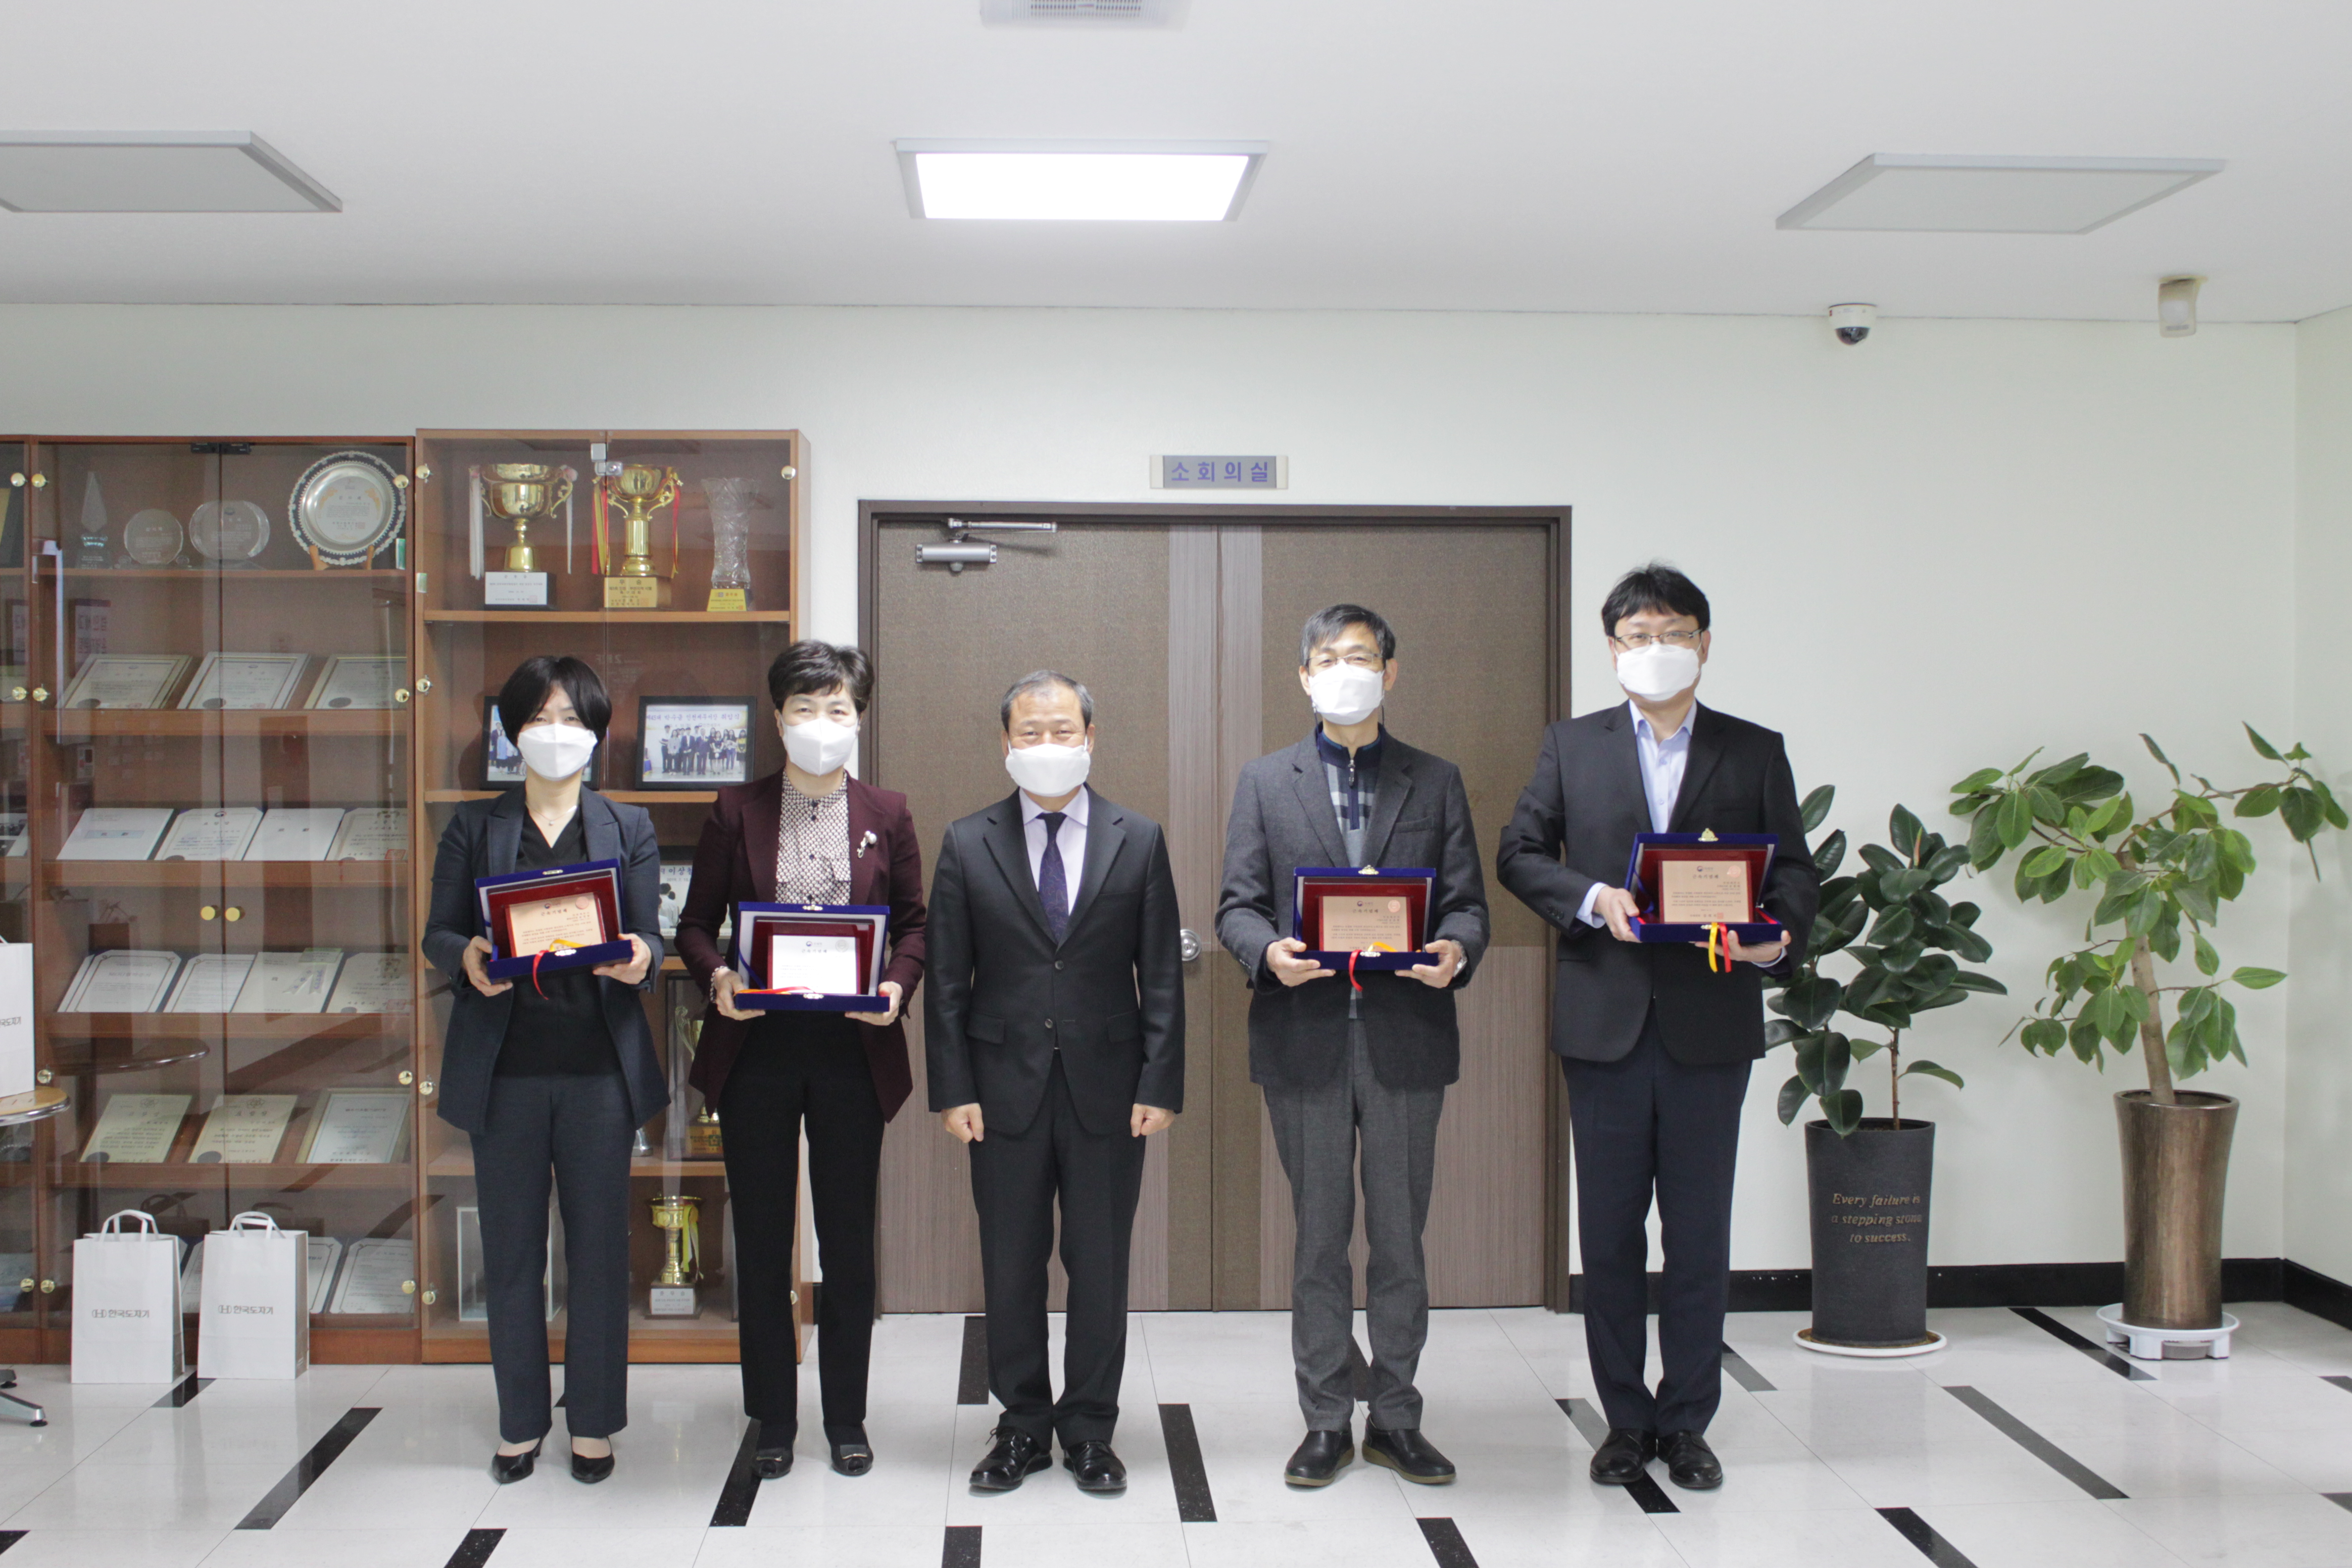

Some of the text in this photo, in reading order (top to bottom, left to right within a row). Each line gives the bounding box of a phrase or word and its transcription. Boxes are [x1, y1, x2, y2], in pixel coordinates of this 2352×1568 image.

[1171, 461, 1268, 482] 소회의실
[0, 1016, 21, 1027] 국도자기
[1833, 1193, 1920, 1208] Every failure is
[1842, 1214, 1893, 1227] stepping
[1850, 1233, 1911, 1243] to success.
[108, 1309, 149, 1318] 한국도자기
[233, 1305, 274, 1315] 한국도자기
